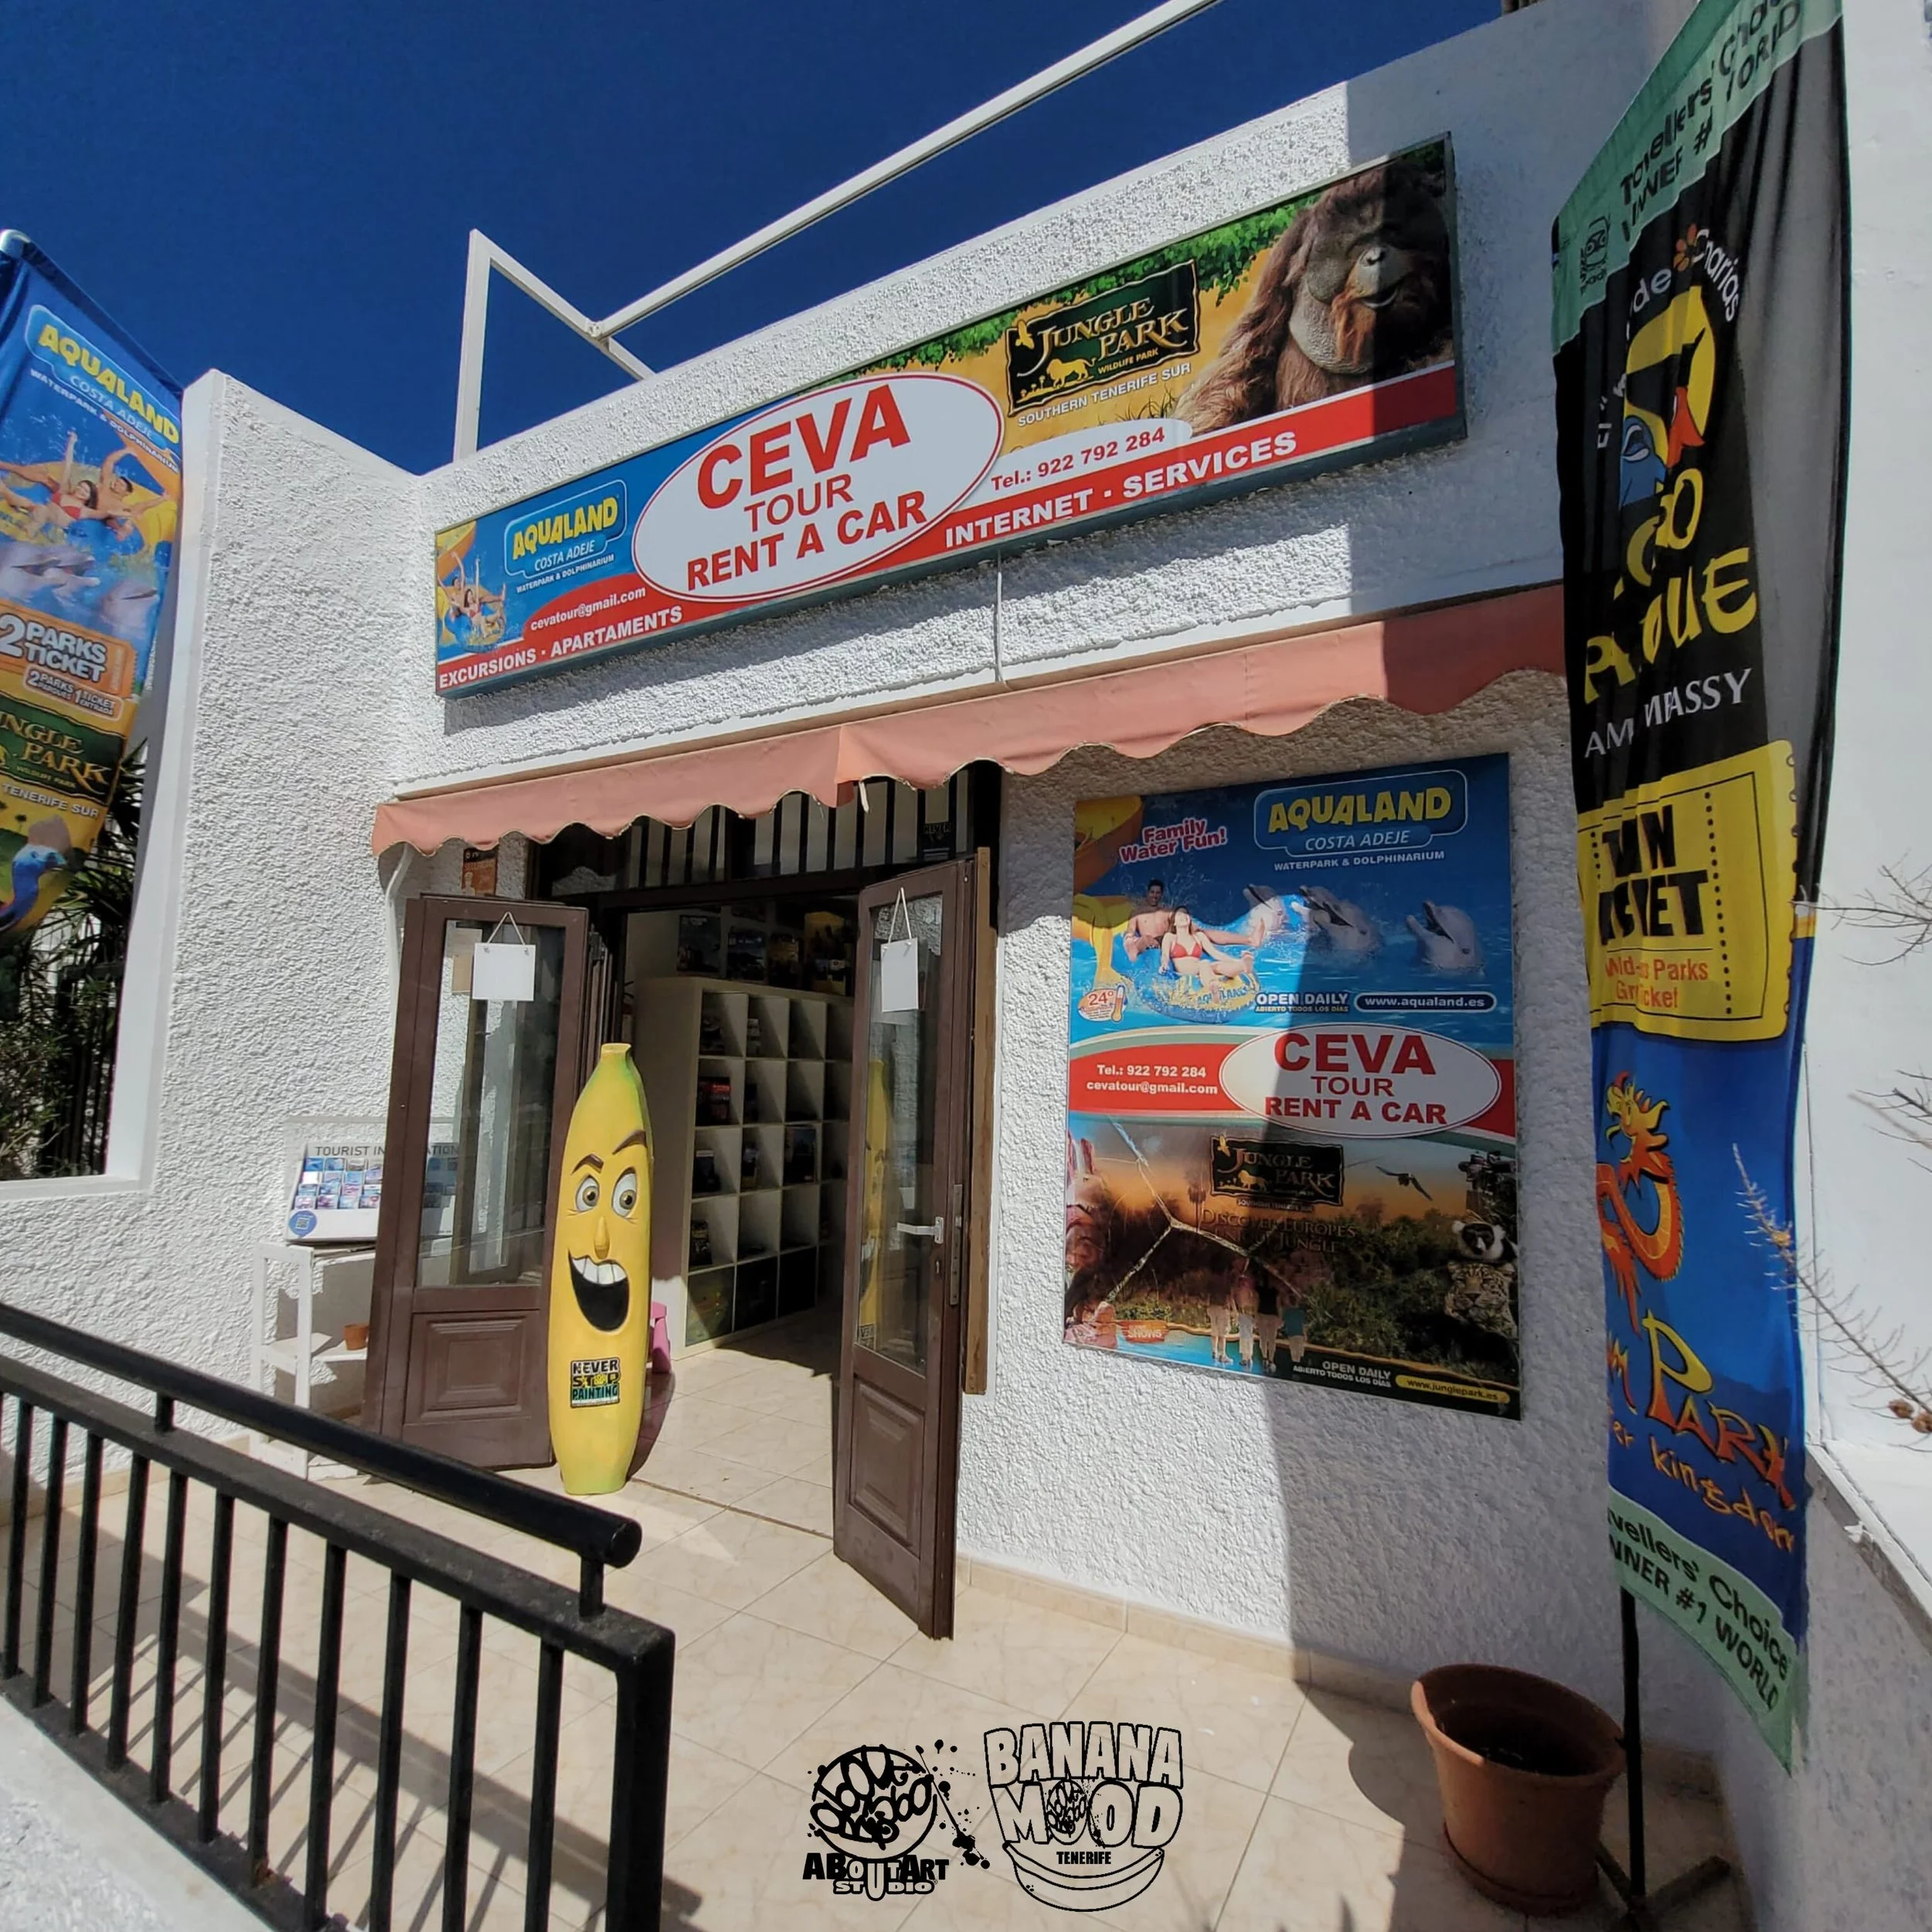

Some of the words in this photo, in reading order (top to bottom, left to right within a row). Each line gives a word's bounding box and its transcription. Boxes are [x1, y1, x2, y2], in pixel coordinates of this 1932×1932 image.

[1632, 268, 1672, 312] de
[1097, 308, 1189, 362] PARK
[1097, 356, 1134, 374] WILDLIFE
[1136, 348, 1158, 361] PARK
[38, 324, 179, 444] AQUALAND
[1018, 398, 1087, 427] SOUTHERN
[1091, 373, 1158, 403] TENERIFE
[1162, 363, 1191, 380] SUR
[30, 369, 97, 418] WATERPARK
[110, 420, 179, 472] DOLPHINARIUM
[69, 375, 114, 411] COSTA
[117, 406, 155, 440] ADEJE
[697, 384, 910, 509] CEVA
[991, 468, 1031, 492] Tel.:
[1037, 454, 1074, 478] 922
[1081, 441, 1118, 465] 792
[1125, 427, 1165, 451] 284
[744, 474, 853, 533] TOUR
[945, 488, 1094, 547] INTERNET
[1124, 430, 1297, 498] SERVICES
[512, 497, 618, 560] AQUALAND
[687, 532, 784, 590] RENT
[796, 522, 824, 559] A
[837, 490, 927, 545] CAR
[534, 553, 564, 572] COSTA
[566, 539, 595, 561] ADEJE
[516, 576, 554, 594] WATERPARK
[563, 554, 614, 579] DOLPHINARIUM
[530, 587, 646, 631] cevatour@gmail.com
[0, 614, 26, 657] 2
[26, 621, 108, 665] PARKS
[439, 648, 536, 689] EXCURSIONS
[550, 605, 683, 658] APARTAMENTS
[25, 641, 106, 682] TICKET
[27, 670, 40, 686] 2
[39, 674, 74, 693] PARKS
[74, 689, 83, 703] 1
[23, 743, 113, 795] PARK
[2, 783, 68, 811] TENERIFE
[1268, 787, 1452, 833] AQUALAND
[1120, 840, 1179, 863] Water
[1182, 826, 1229, 851] Fun!
[1142, 818, 1206, 845] Family
[1305, 835, 1355, 852] COSTA
[1360, 829, 1411, 848] ADEJE
[1274, 858, 1340, 872] WATERPARK
[1343, 857, 1350, 866] &
[1353, 851, 1445, 866] DOLPHINARIUM
[1654, 958, 1709, 981] Parks
[1256, 993, 1299, 1005] OPEN
[1305, 993, 1348, 1005] DAILY
[1365, 996, 1485, 1008] www.aqualand.es
[1274, 1032, 1437, 1075] CEVA
[1087, 1080, 1218, 1095] cevatour@gmail.com
[1097, 1064, 1123, 1076] Tel.:
[1127, 1065, 1151, 1077] 922
[1155, 1066, 1179, 1077] 792
[1182, 1066, 1207, 1078] 284
[1311, 1076, 1394, 1097] TOUR
[1265, 1096, 1342, 1123] RENT
[1350, 1100, 1372, 1121] A
[1379, 1101, 1447, 1125] CAR
[315, 1145, 372, 1156] TOURIST
[1275, 1169, 1337, 1198] PARK
[573, 1359, 618, 1374] NEVER
[1293, 1365, 1325, 1376] ABIERTO
[1327, 1371, 1353, 1381] TODOS
[1355, 1376, 1371, 1384] LOS
[1322, 1360, 1355, 1374] OPEN
[1359, 1366, 1391, 1379] DAILY
[573, 1385, 618, 1400] PAINTING
[1406, 1379, 1498, 1400] www.junglepark.es
